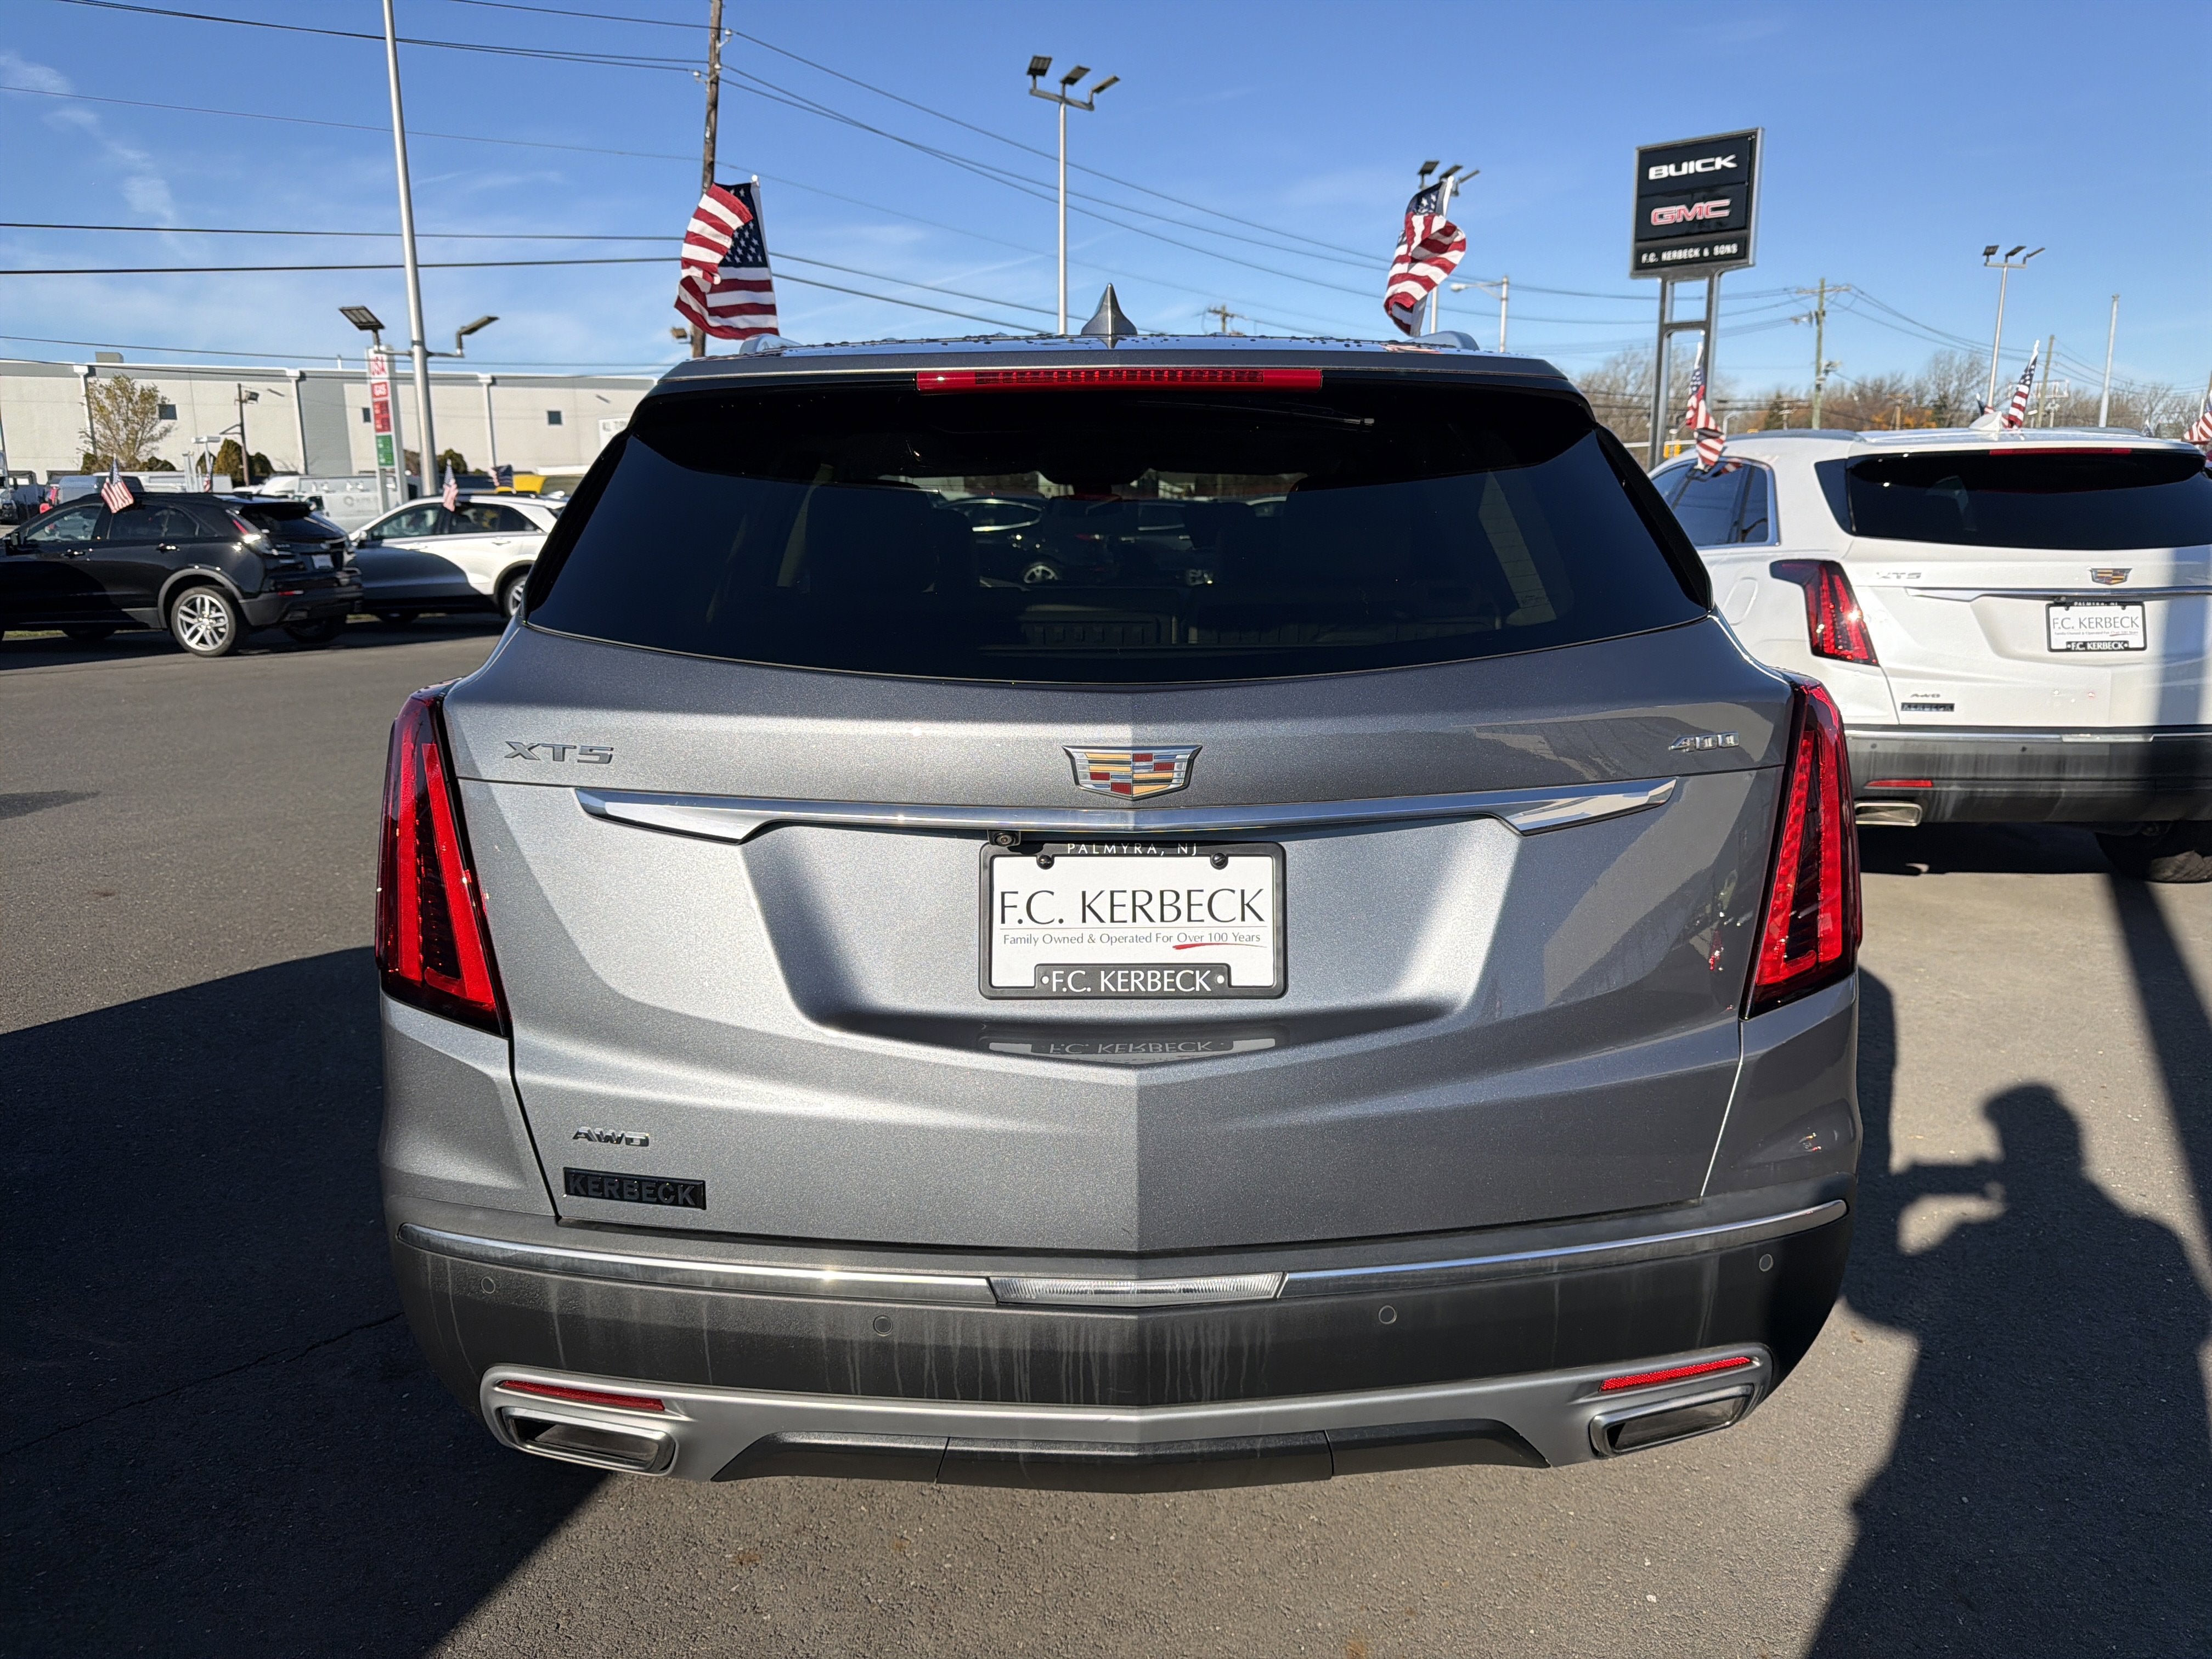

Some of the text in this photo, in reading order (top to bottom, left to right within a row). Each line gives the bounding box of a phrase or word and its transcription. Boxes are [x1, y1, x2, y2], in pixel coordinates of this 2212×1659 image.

[1649, 154, 1737, 180] BUICK
[1651, 198, 1731, 225] GMC
[1662, 247, 1700, 261] KERBECK
[1713, 243, 1738, 256] SONS
[2053, 616, 2139, 629] F.C. KERBECK
[2087, 642, 2125, 650] KERBECK
[1668, 731, 1740, 752] 400
[1068, 843, 1197, 856] PALMYRA, NJ
[1000, 888, 1265, 924] F.C. KERBECK
[1003, 932, 1261, 946] Family Owned & Operated For Over 100 Years
[1052, 970, 1211, 992] F.C. KERBECK
[572, 1126, 650, 1147] AWD
[568, 1175, 696, 1206] KERBECK
